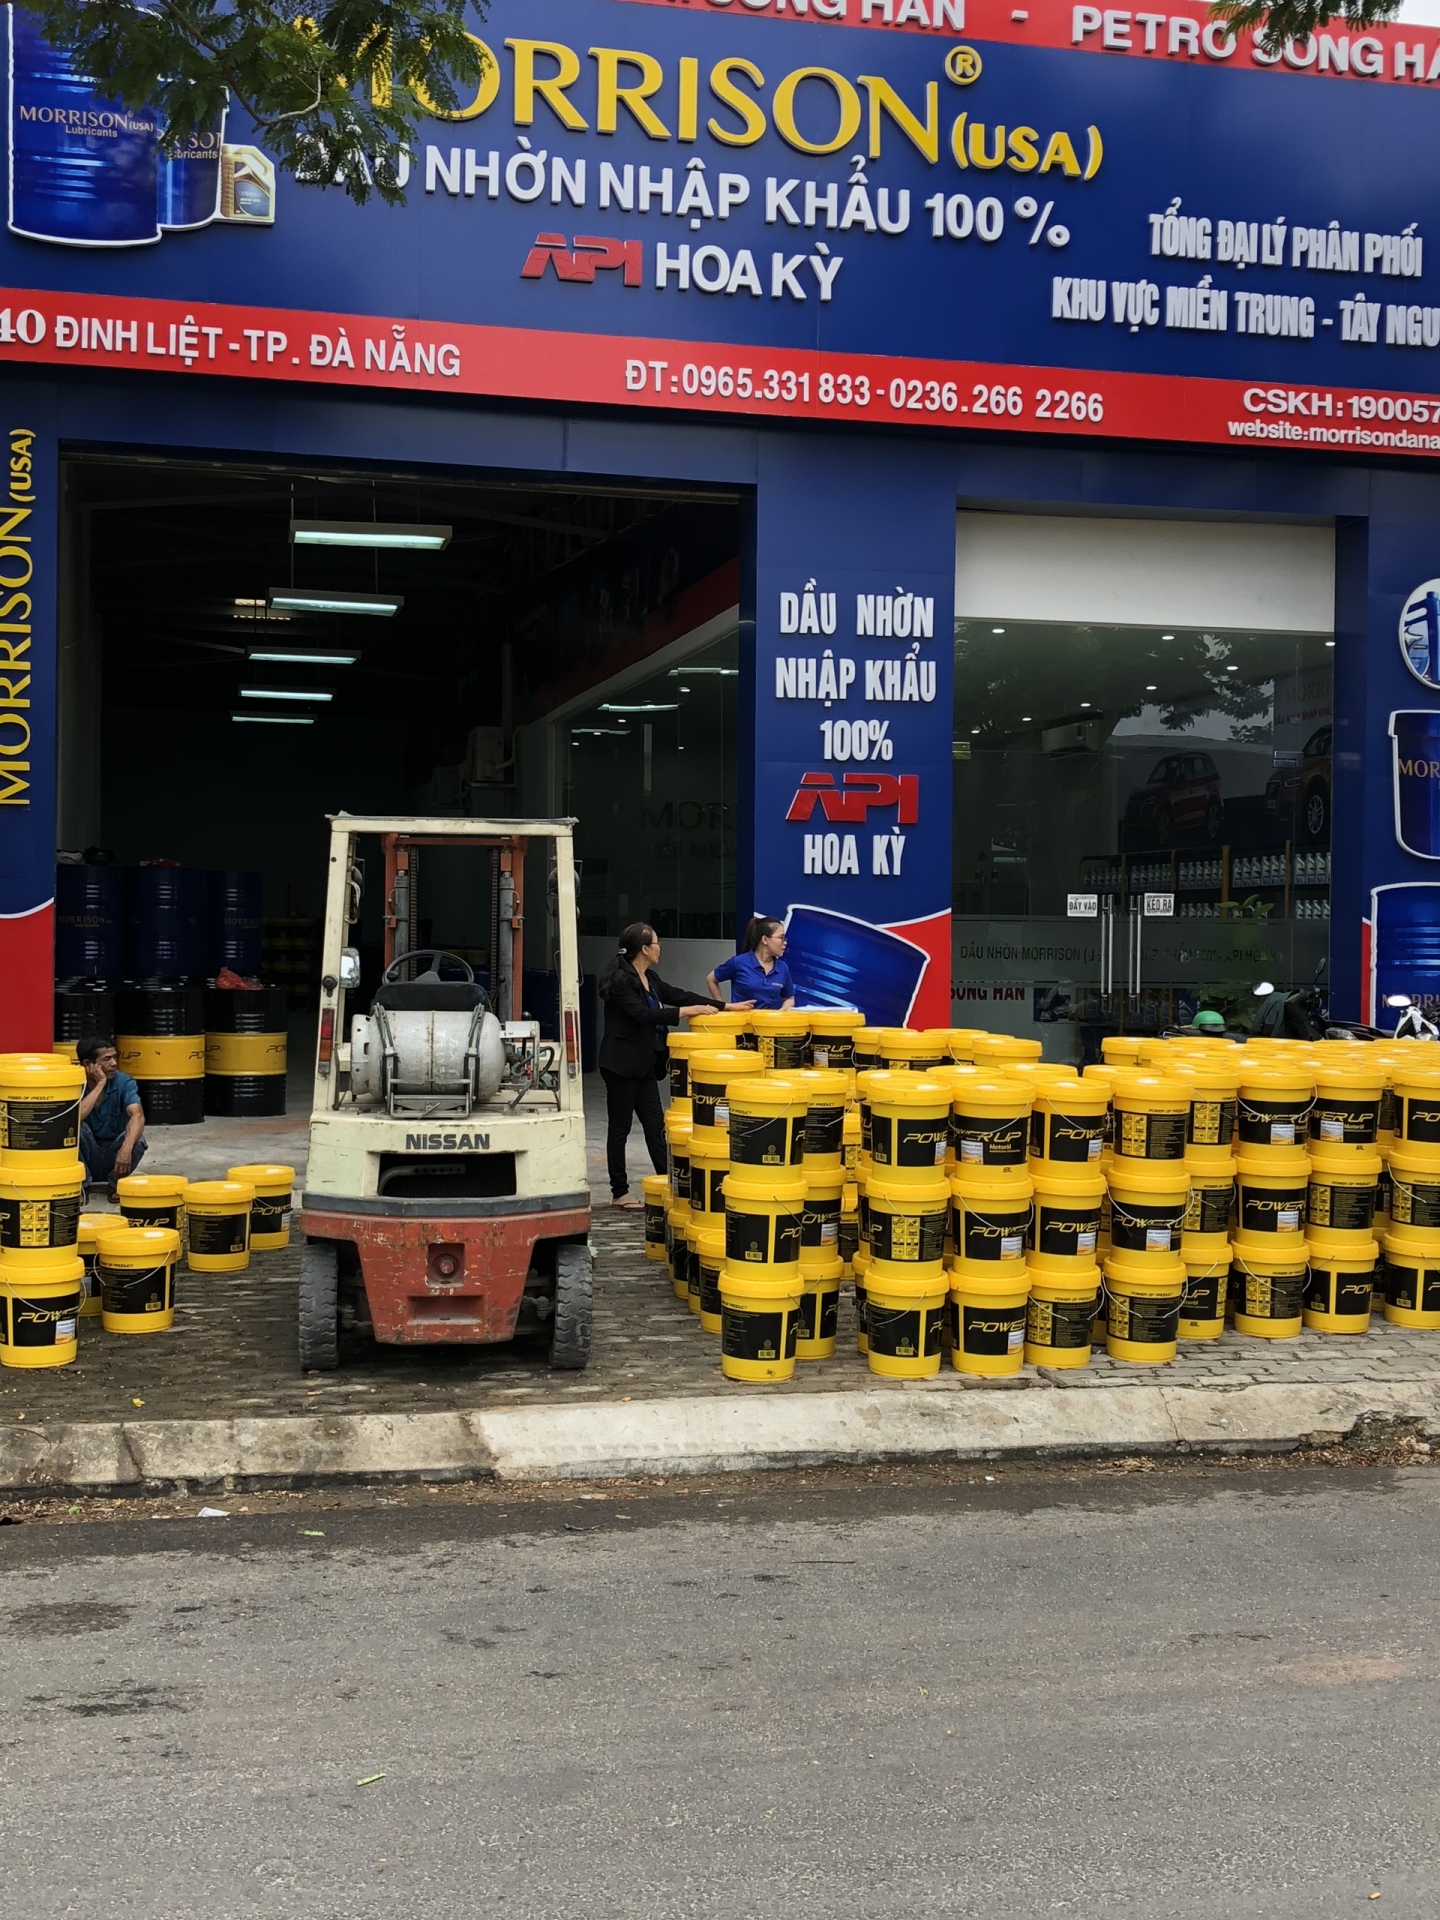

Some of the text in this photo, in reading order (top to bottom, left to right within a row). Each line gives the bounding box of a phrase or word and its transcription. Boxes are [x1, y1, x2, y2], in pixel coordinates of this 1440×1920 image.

[1072, 5, 1237, 61] PETRO
[20, 104, 154, 133] MORRISON (USA)
[65, 124, 118, 139] Lubricants
[951, 111, 1104, 181] (USA)
[425, 136, 586, 206] NHỜN
[599, 157, 750, 230] NHẬP
[765, 155, 910, 235] KHẨU
[925, 192, 1004, 242] 100
[1013, 195, 1071, 248] %
[520, 232, 844, 301] API HOA KỲ
[1149, 197, 1423, 278] TỔNG ĐẠI LÝ PHÂN PHỐI
[1052, 276, 1107, 323] KHU
[1112, 279, 1160, 333] VỰC
[1165, 274, 1228, 331] MIỀN
[1234, 291, 1315, 338] TRUNG
[1339, 292, 1381, 343] TÂY
[1385, 304, 1440, 347] NGU
[55, 315, 137, 353] ĐINH
[147, 314, 222, 366] LIỆT
[310, 327, 355, 369] ĐÀ
[365, 325, 461, 377] NẴNG
[1035, 389, 1105, 422] 2266
[0, 428, 36, 806] MORRISON (USA)
[780, 578, 934, 638] DẦU NHỜN
[775, 642, 937, 707] NHẬP KHẨU
[819, 719, 894, 762] 100%
[785, 771, 920, 824] API
[804, 826, 906, 877] HOA KỲ
[1021, 947, 1081, 961] MORRISON
[405, 1133, 490, 1151] NISSAN
